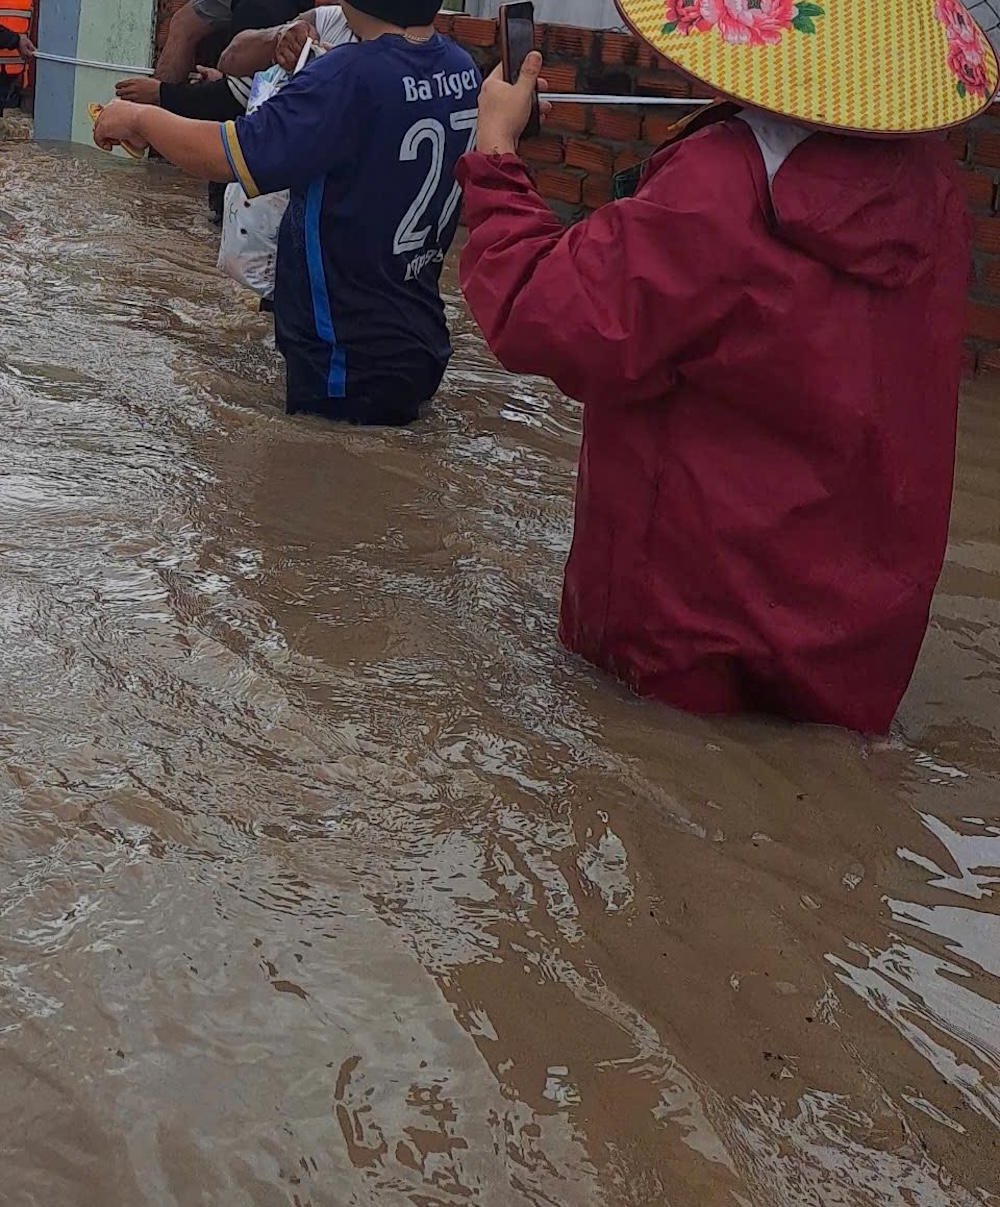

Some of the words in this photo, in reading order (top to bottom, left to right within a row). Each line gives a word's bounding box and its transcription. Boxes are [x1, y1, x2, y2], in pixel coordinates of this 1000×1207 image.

[402, 75, 433, 102] Ba
[432, 68, 478, 100] Tiger
[392, 108, 479, 255] 27
